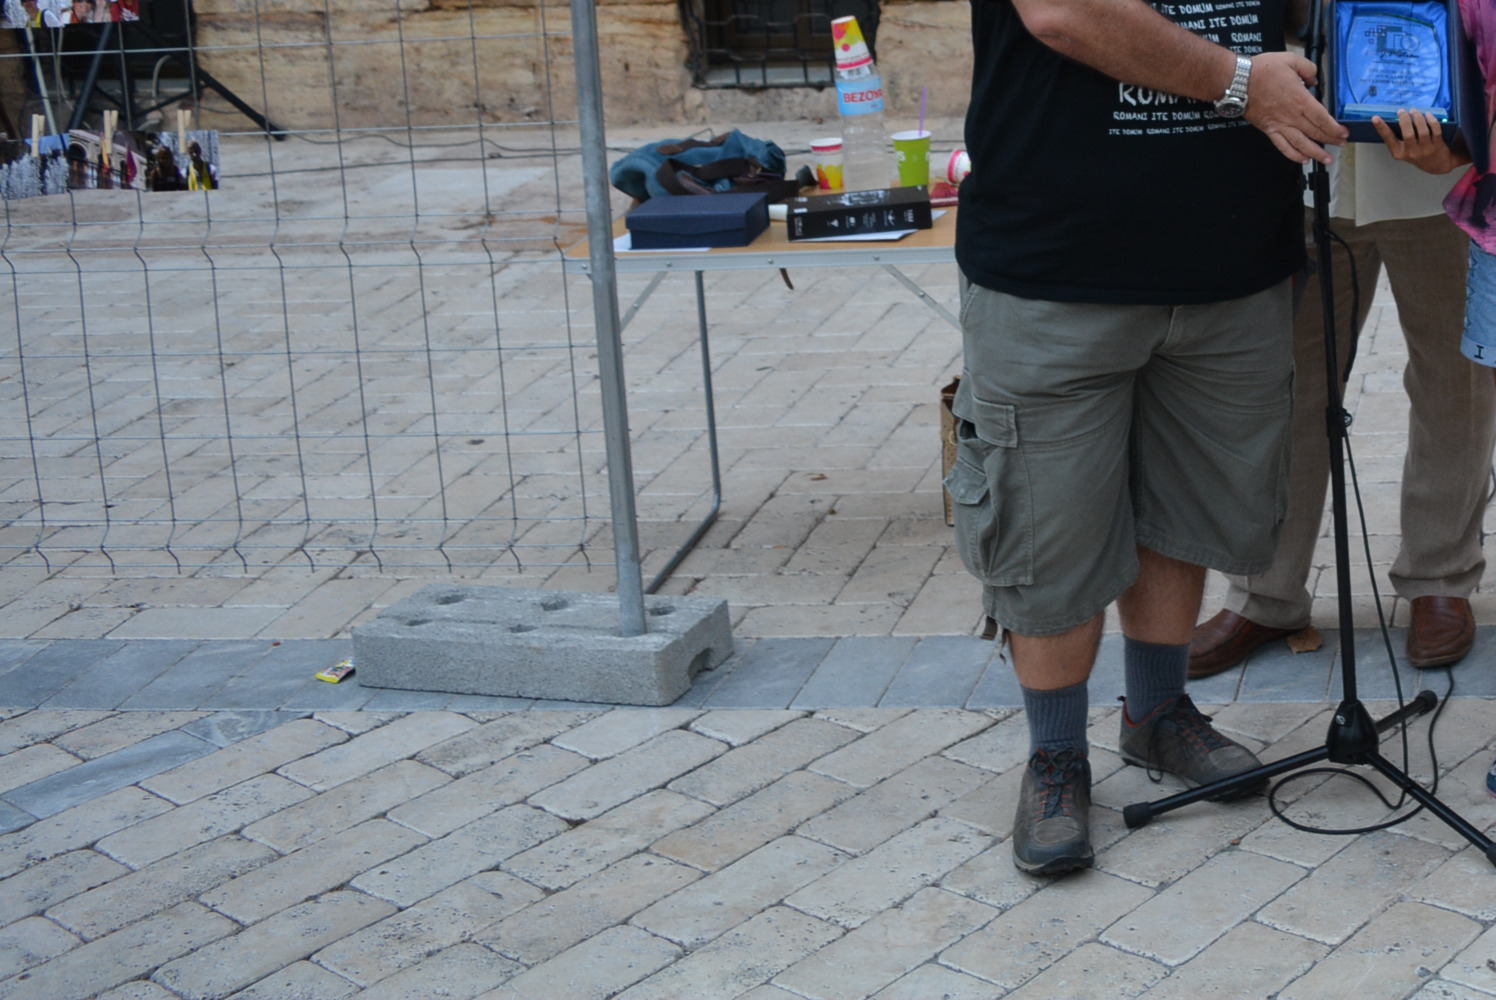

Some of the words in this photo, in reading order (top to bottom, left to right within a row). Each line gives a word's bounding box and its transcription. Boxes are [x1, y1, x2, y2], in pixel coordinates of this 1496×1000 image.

[1178, 2, 1215, 15] DOMUM
[1208, 16, 1228, 29] ITE
[1229, 14, 1260, 26] DOMUM
[1230, 32, 1263, 43] ROMANI
[1113, 110, 1149, 121] ROMANI
[1151, 111, 1169, 121] ITE
[1172, 111, 1201, 121] DOMUM
[1473, 344, 1485, 360] I
